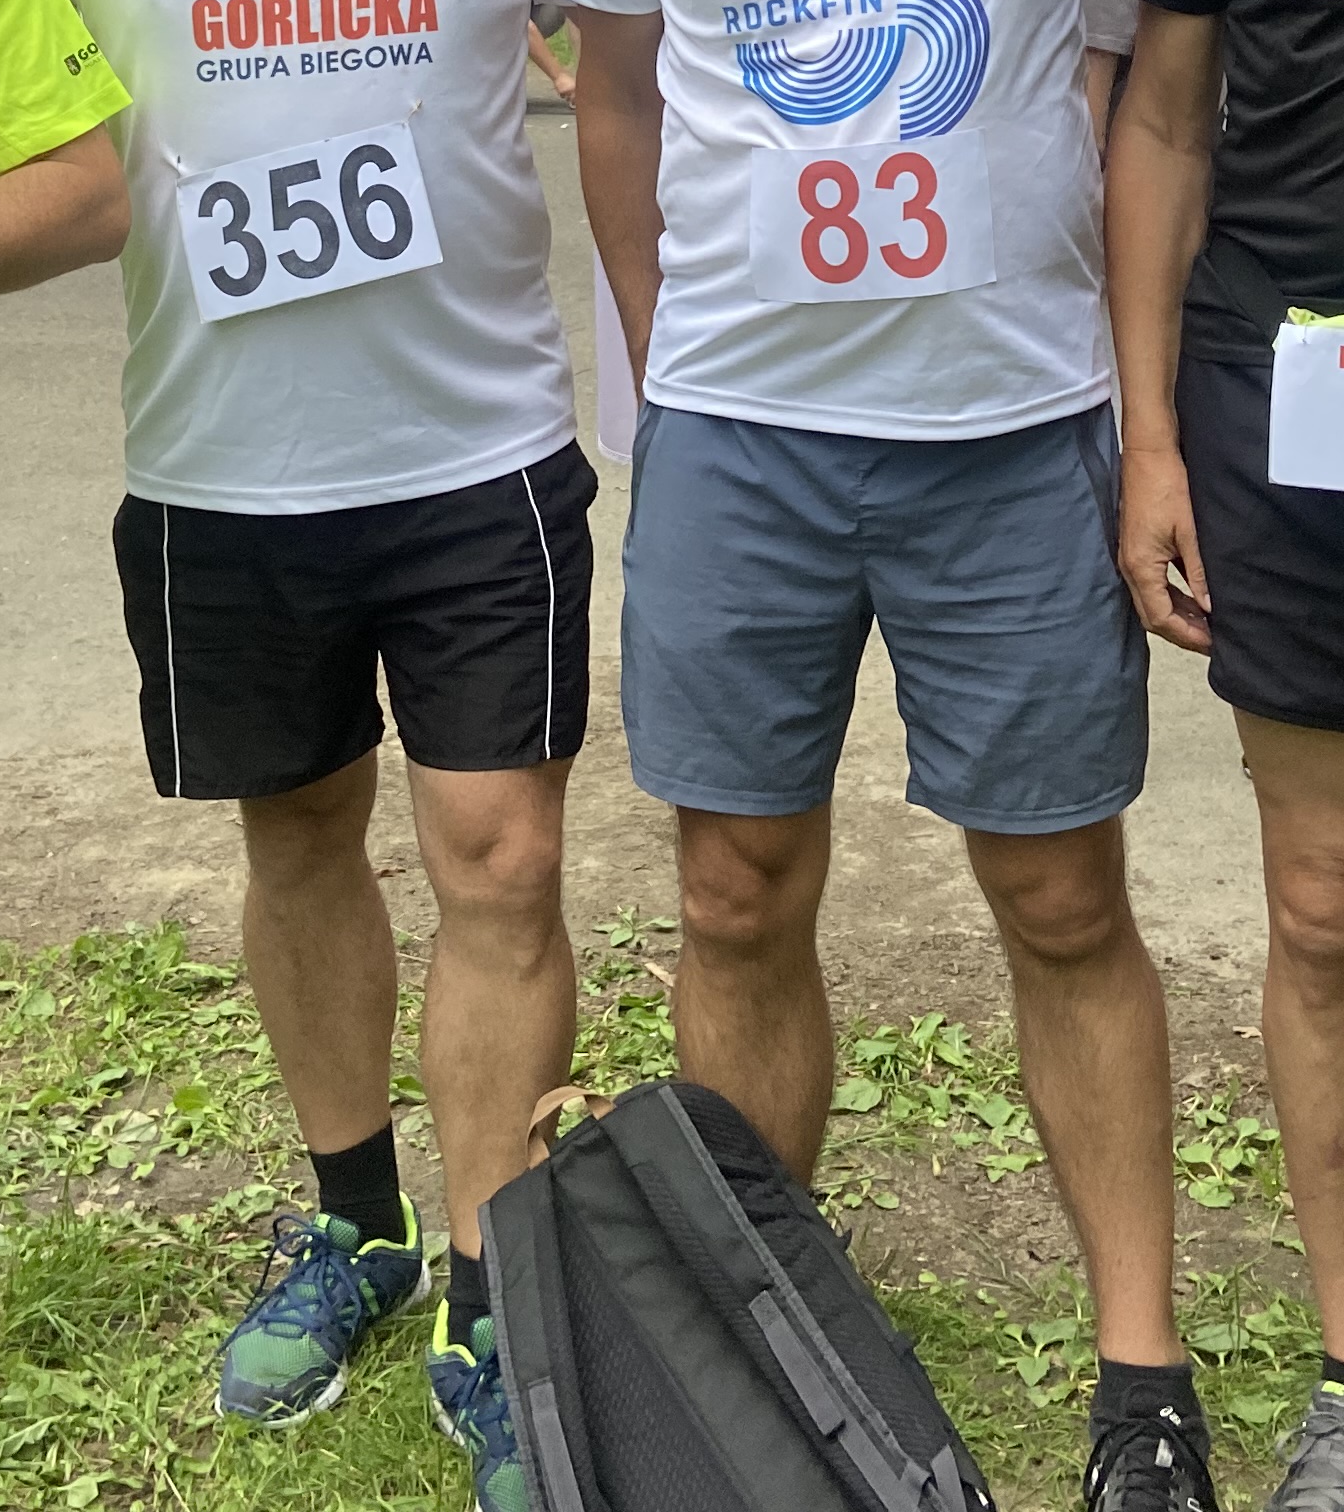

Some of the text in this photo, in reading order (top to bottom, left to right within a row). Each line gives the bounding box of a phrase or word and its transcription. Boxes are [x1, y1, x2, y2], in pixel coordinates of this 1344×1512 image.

[196, 42, 434, 82] GRUPA BIEGOWA
[197, 143, 414, 298] 356
[797, 151, 948, 285] 83
